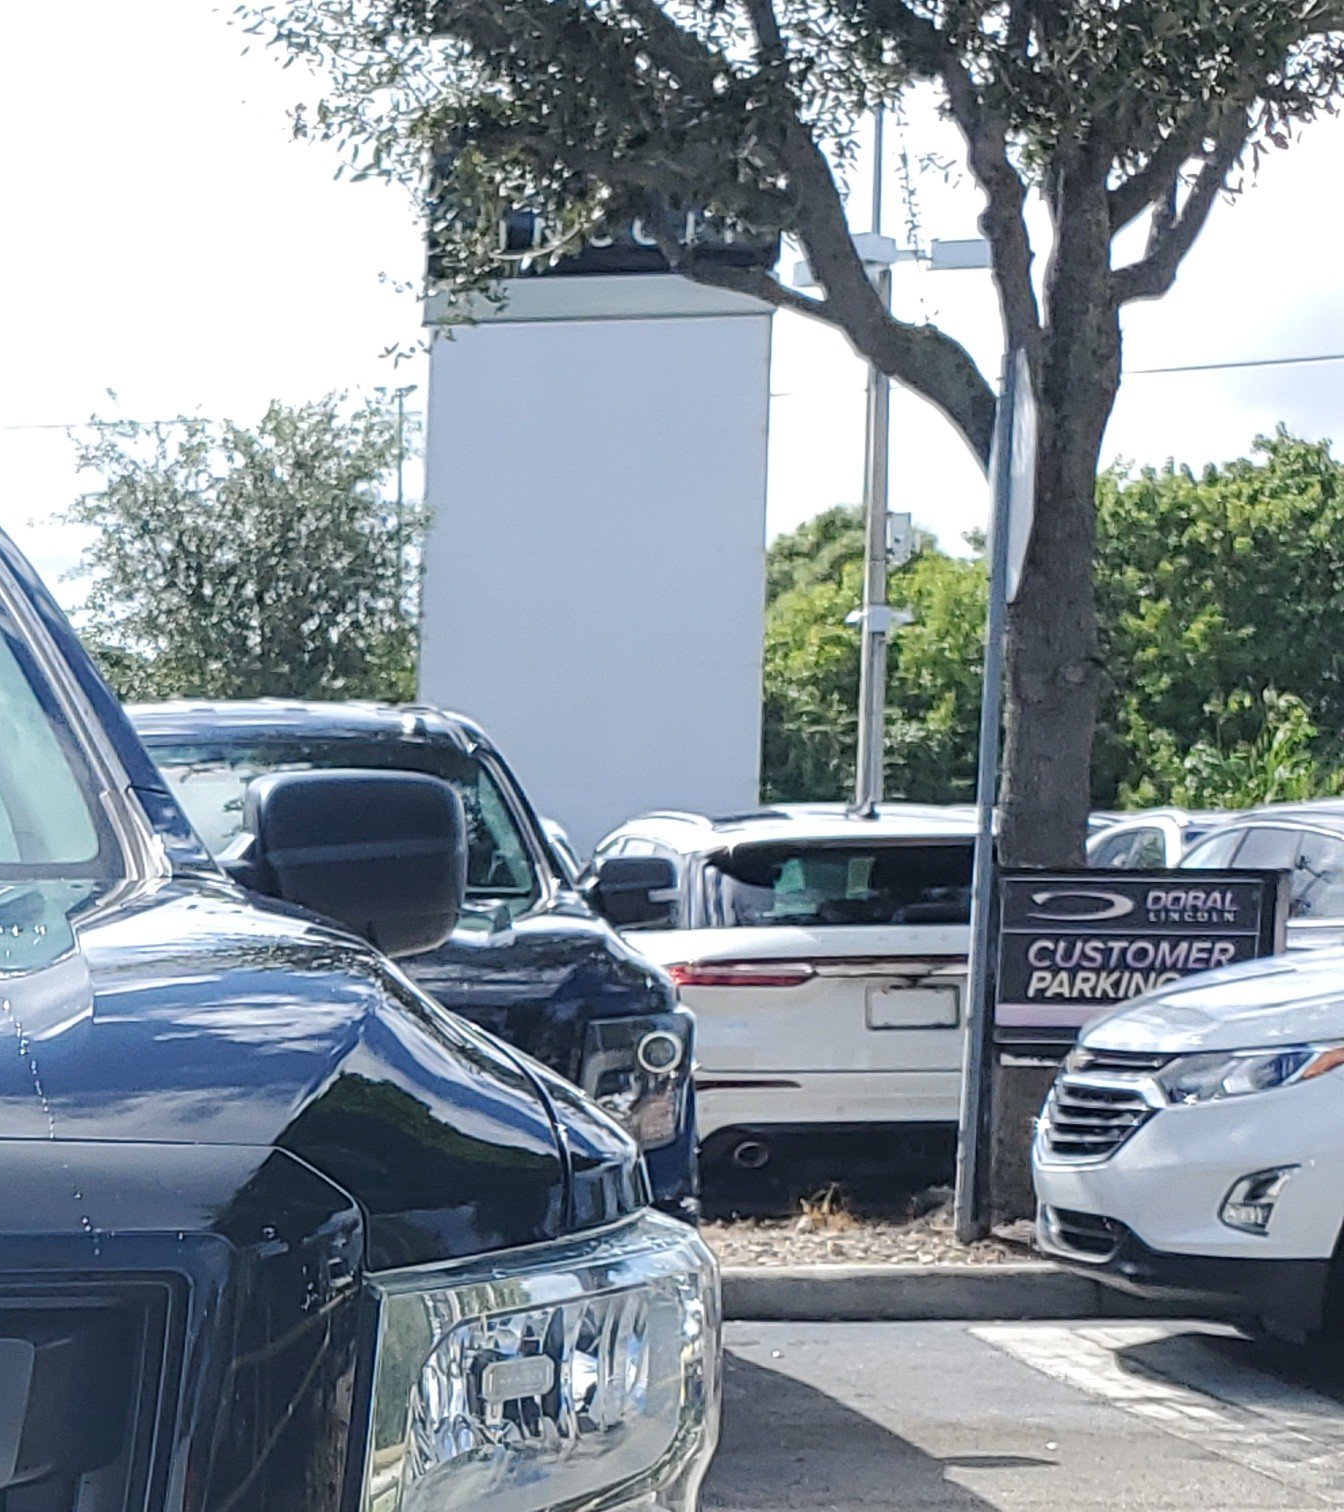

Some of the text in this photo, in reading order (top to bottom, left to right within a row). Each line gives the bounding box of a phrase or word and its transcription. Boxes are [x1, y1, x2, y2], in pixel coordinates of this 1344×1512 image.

[1146, 889, 1239, 911] DORAL
[1148, 911, 1236, 922] LINCOLN
[1027, 939, 1237, 969] CUSTOMER
